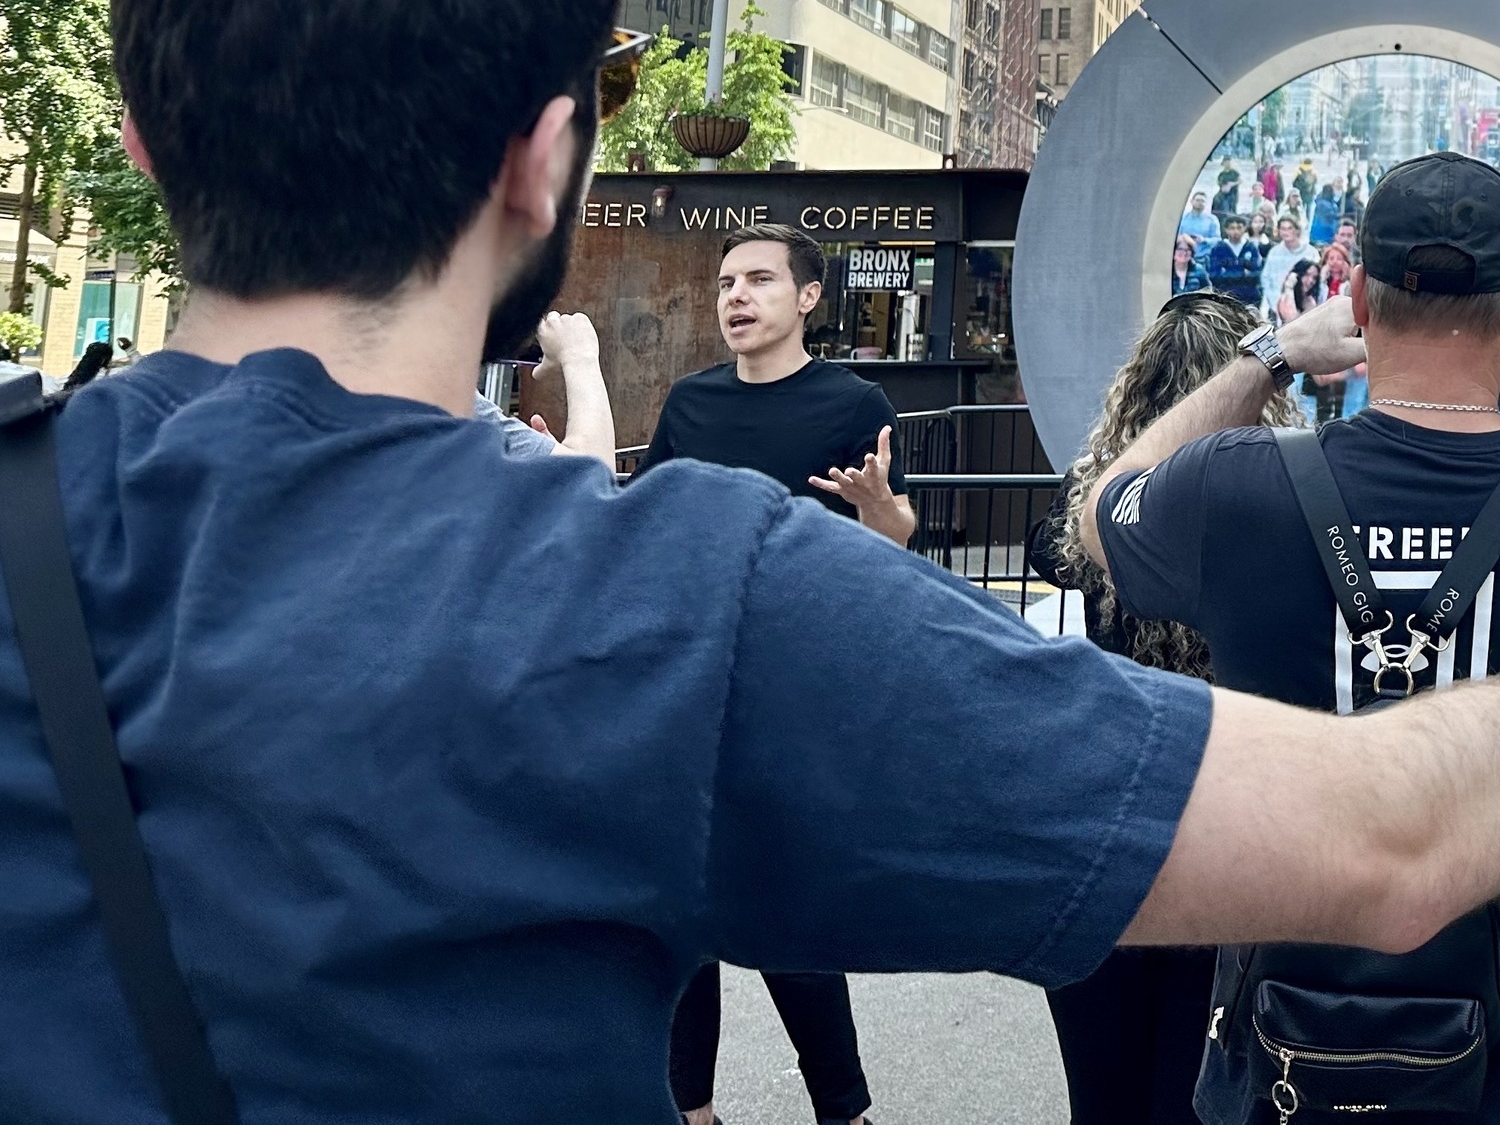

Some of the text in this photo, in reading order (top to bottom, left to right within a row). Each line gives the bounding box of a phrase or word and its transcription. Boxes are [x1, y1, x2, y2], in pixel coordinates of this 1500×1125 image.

[582, 203, 935, 231] EER WINE COFFEE
[849, 249, 911, 271] BRONX
[848, 272, 910, 288] BREWERY
[1327, 525, 1374, 623] ROMEO GIG
[1426, 587, 1460, 633] ROME
